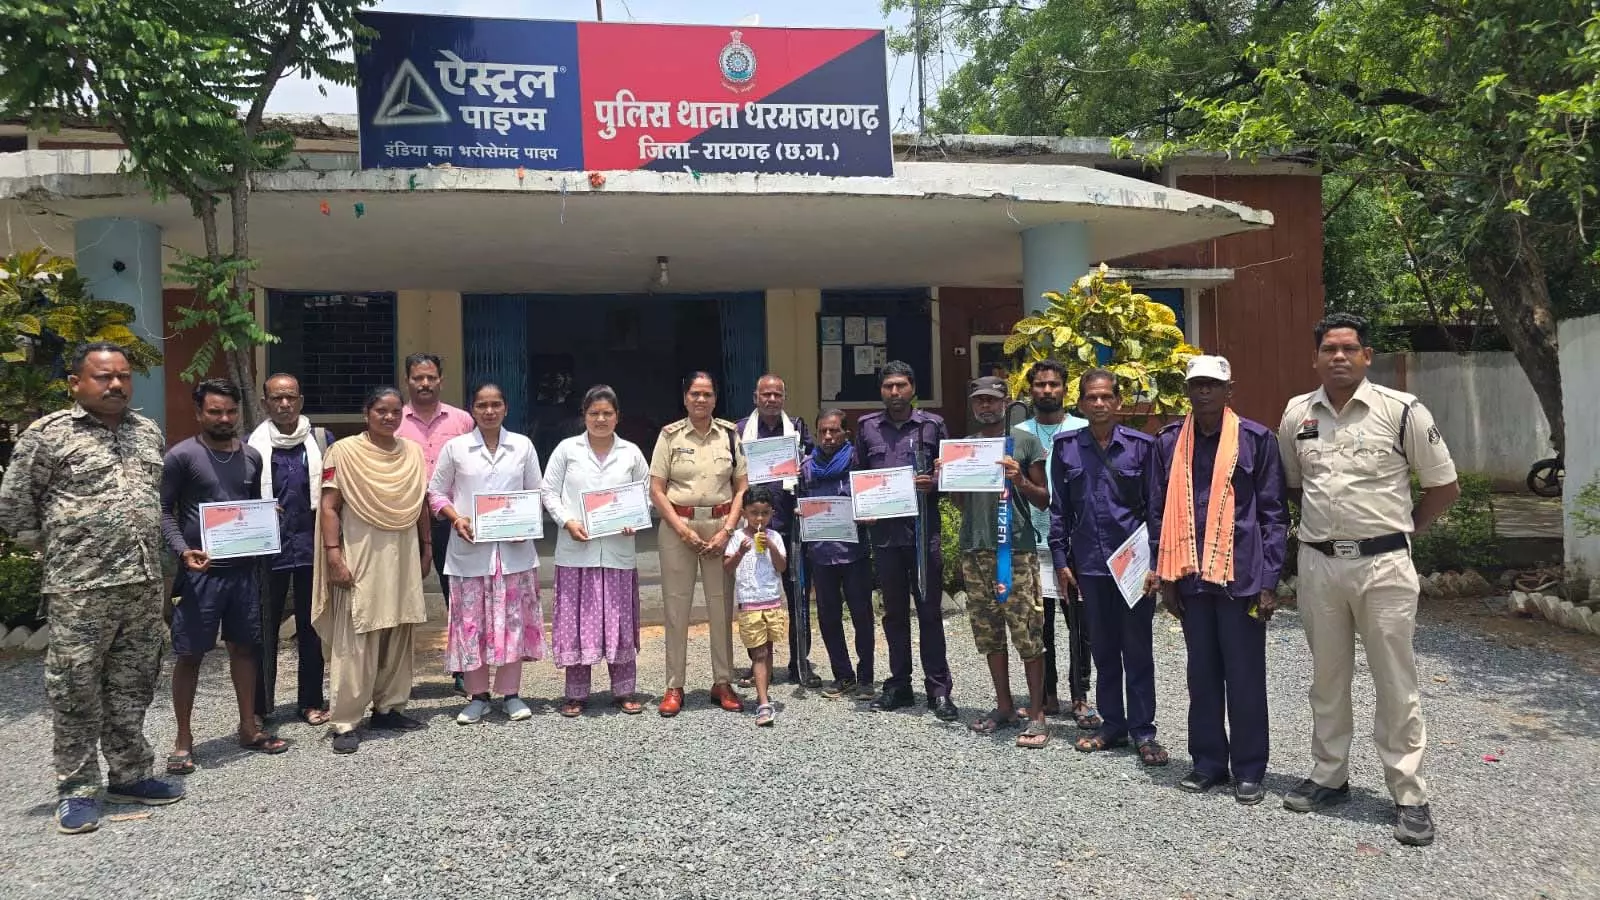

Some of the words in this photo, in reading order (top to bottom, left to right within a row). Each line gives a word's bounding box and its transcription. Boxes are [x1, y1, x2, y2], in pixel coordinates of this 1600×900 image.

[459, 106, 547, 135] पाइप्स
[594, 89, 671, 139] पुलिस
[677, 100, 739, 129] थाना
[745, 102, 879, 136] धरमजयगढ़
[385, 141, 427, 157] इंडिया
[433, 145, 453, 157] का
[458, 142, 519, 160] भरोसेमंद
[524, 147, 558, 160] पाइप
[775, 143, 840, 161] (छ.ग.)
